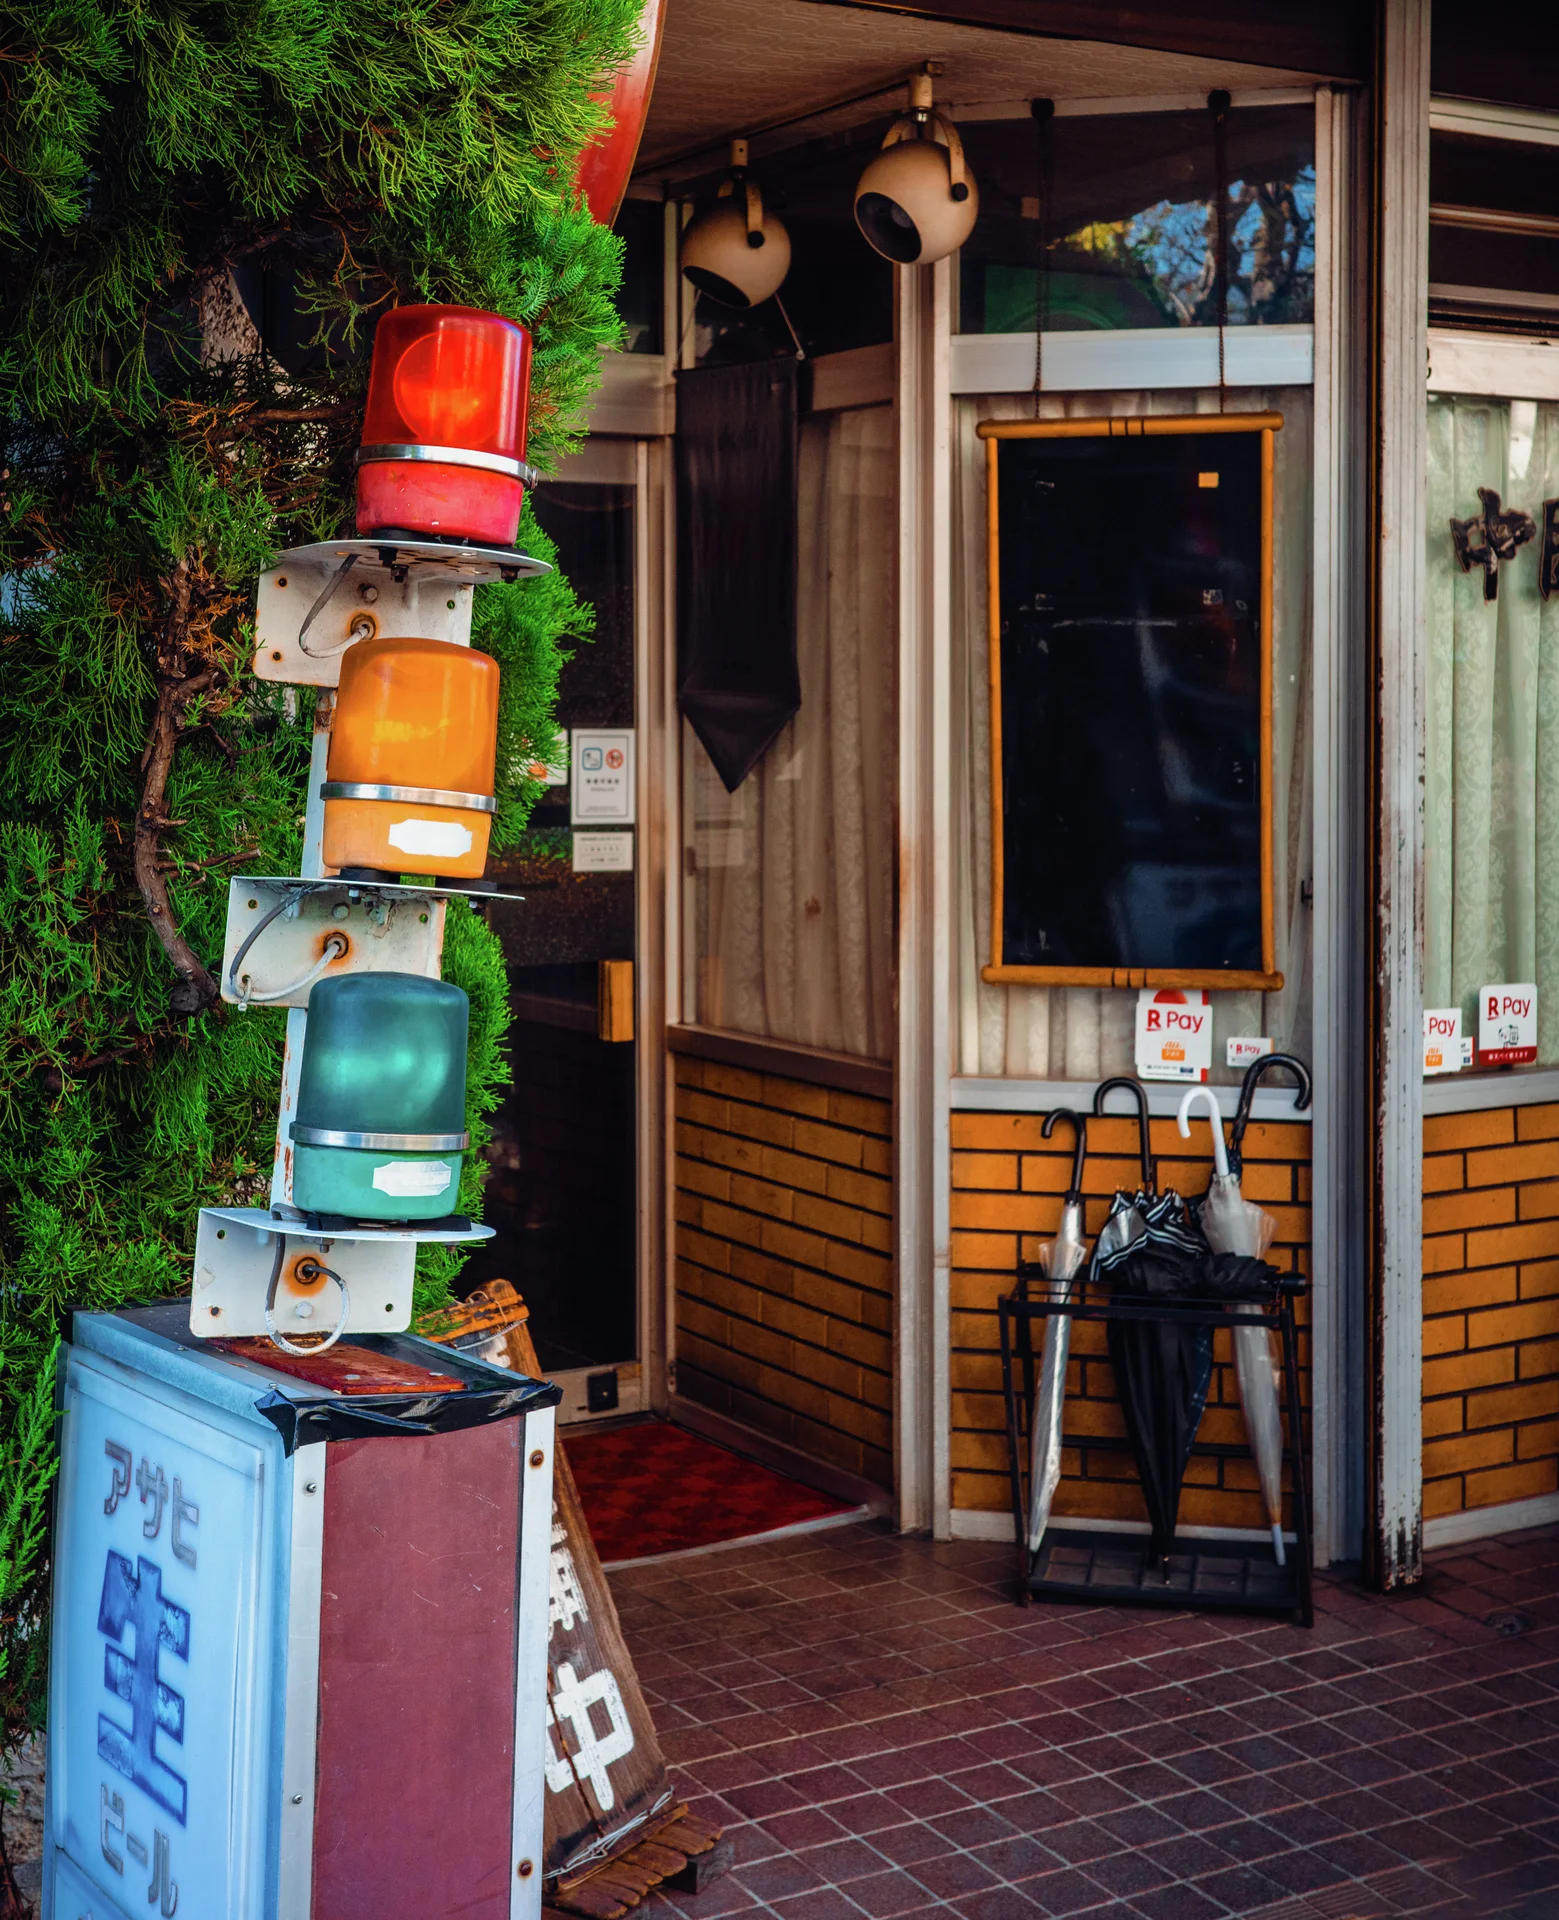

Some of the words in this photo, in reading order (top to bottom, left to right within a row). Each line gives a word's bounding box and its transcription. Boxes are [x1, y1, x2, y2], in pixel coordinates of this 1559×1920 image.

[1146, 1009, 1162, 1031] R
[1167, 1011, 1204, 1034] Pay
[1428, 1017, 1456, 1037] Pay
[1488, 996, 1499, 1020] R
[1503, 996, 1531, 1018] Pay
[104, 1438, 199, 1571] アサヒ
[97, 1549, 191, 1828] 生
[101, 1783, 178, 1919] ビール
